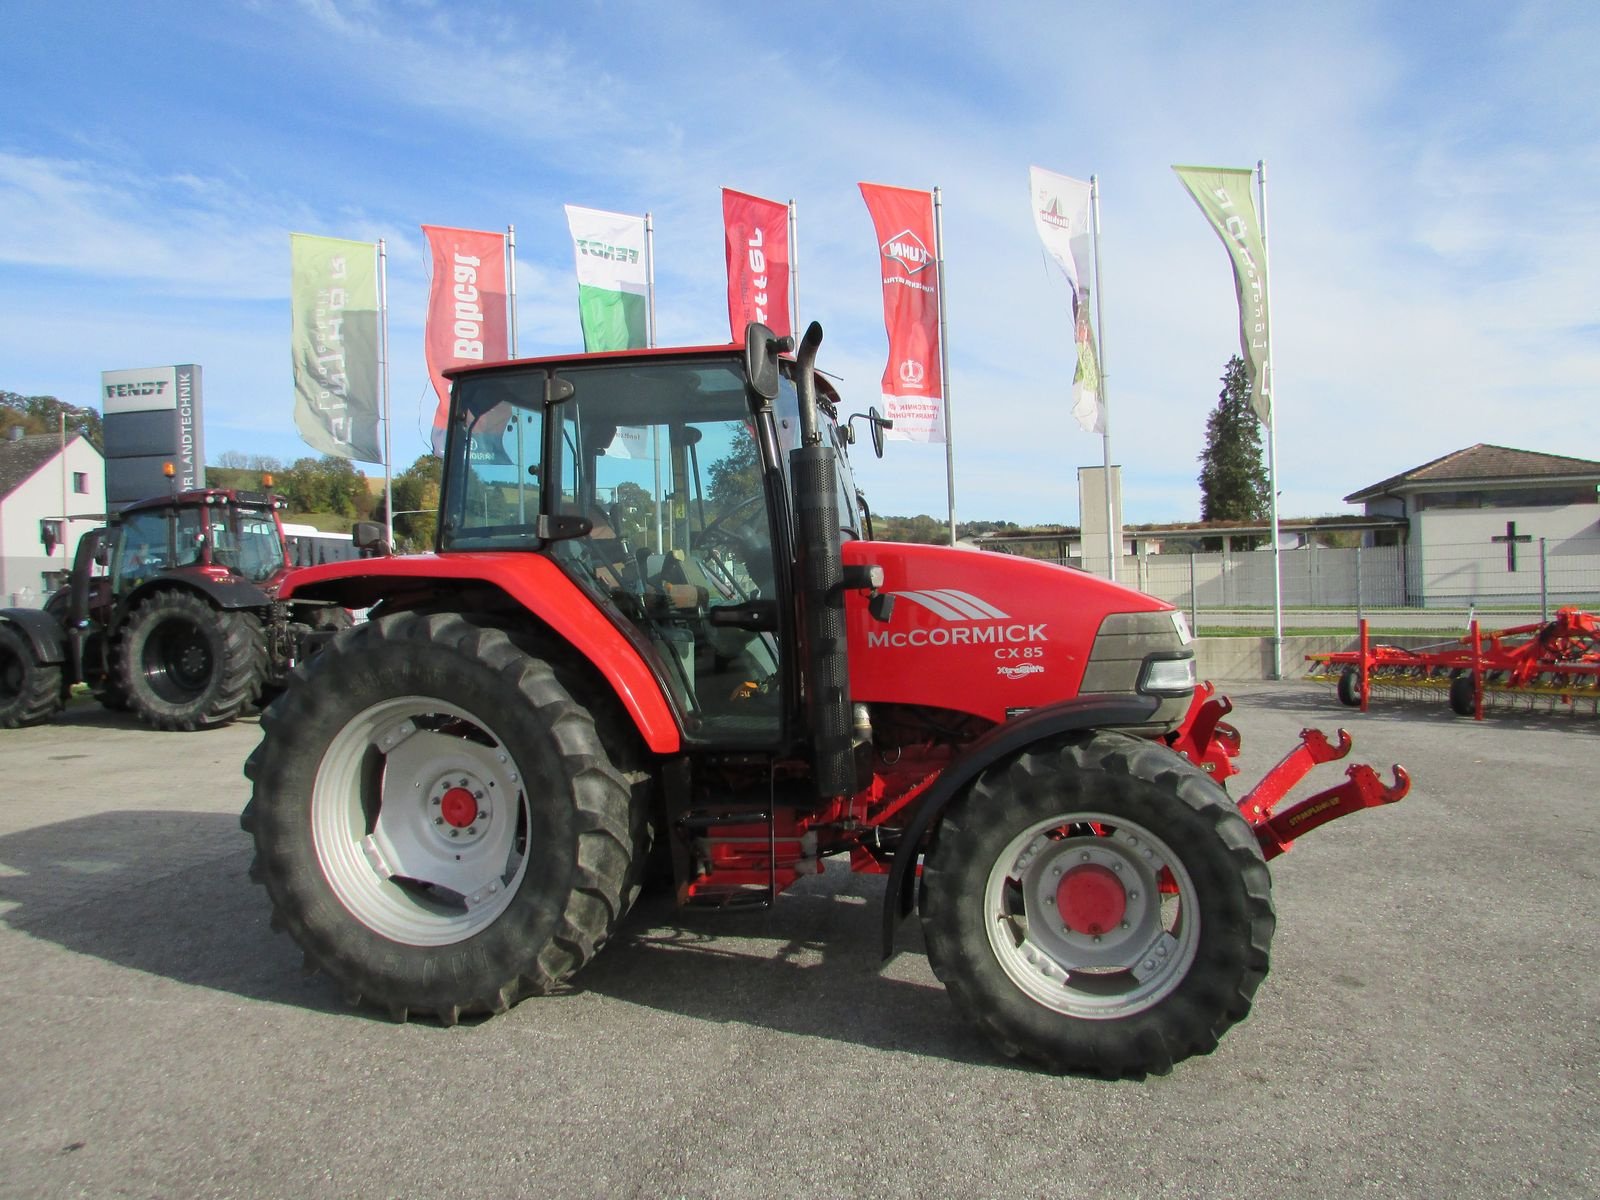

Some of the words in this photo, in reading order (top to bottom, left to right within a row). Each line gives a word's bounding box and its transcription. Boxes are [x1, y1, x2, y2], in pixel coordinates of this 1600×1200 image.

[105, 381, 168, 398] FENDT
[179, 373, 193, 473] LANDTECHNIK
[994, 648, 1020, 659] CX
[1023, 647, 1043, 658] 85
